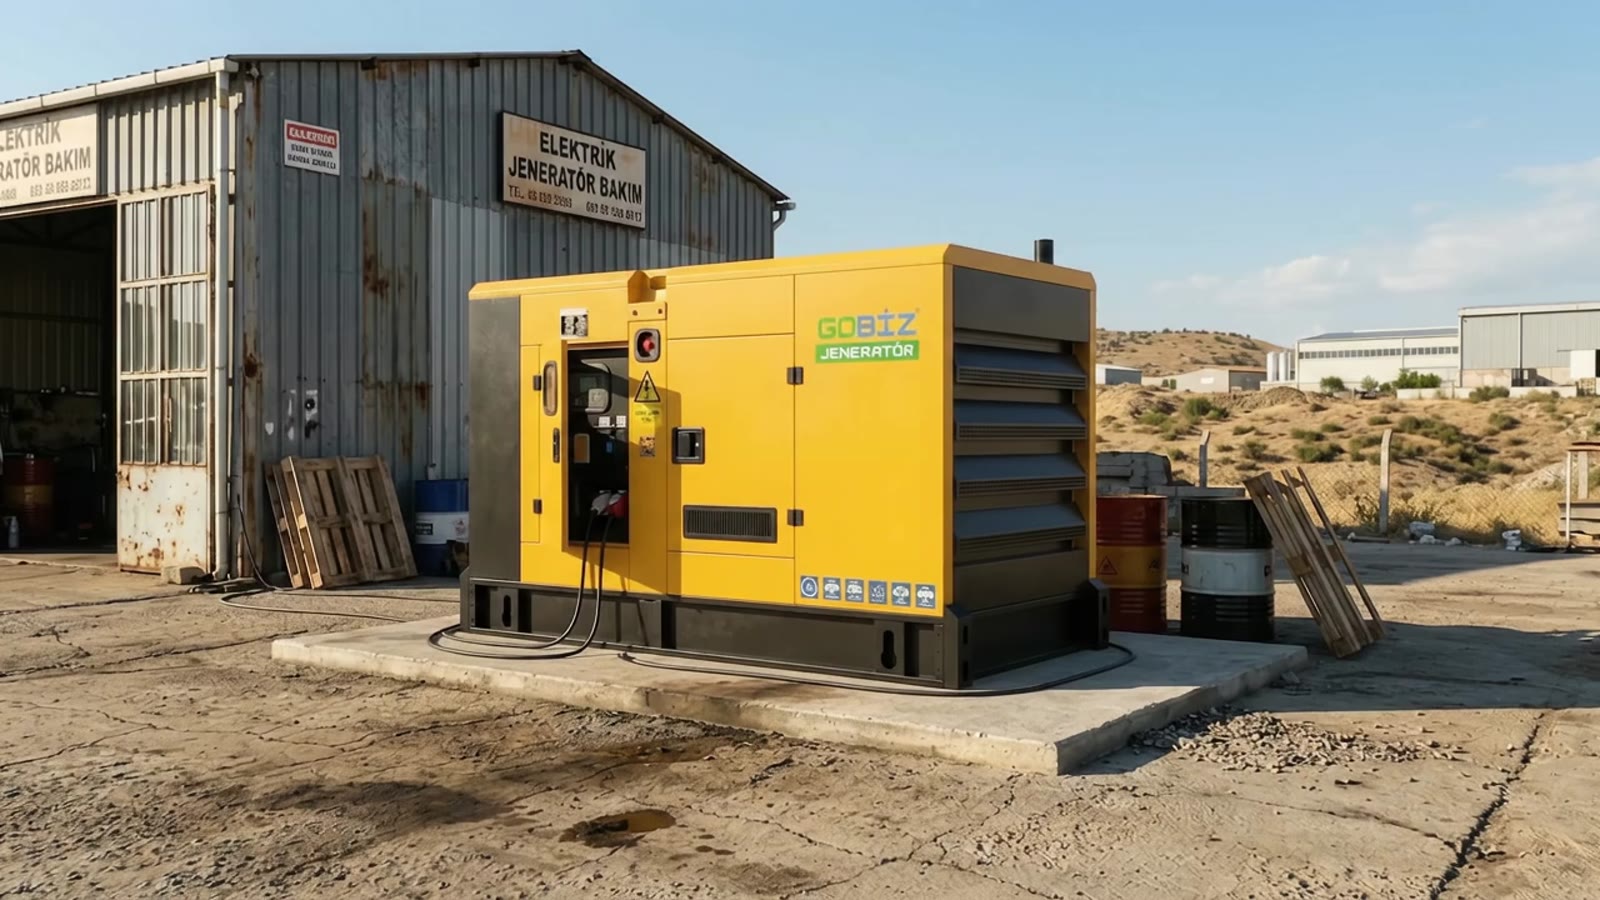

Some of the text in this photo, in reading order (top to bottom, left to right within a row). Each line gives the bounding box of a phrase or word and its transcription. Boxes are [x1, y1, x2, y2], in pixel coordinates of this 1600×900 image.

[45, 146, 91, 175] BAKIM
[540, 131, 616, 171] ELEKTRİK
[600, 175, 642, 205] BAKIM
